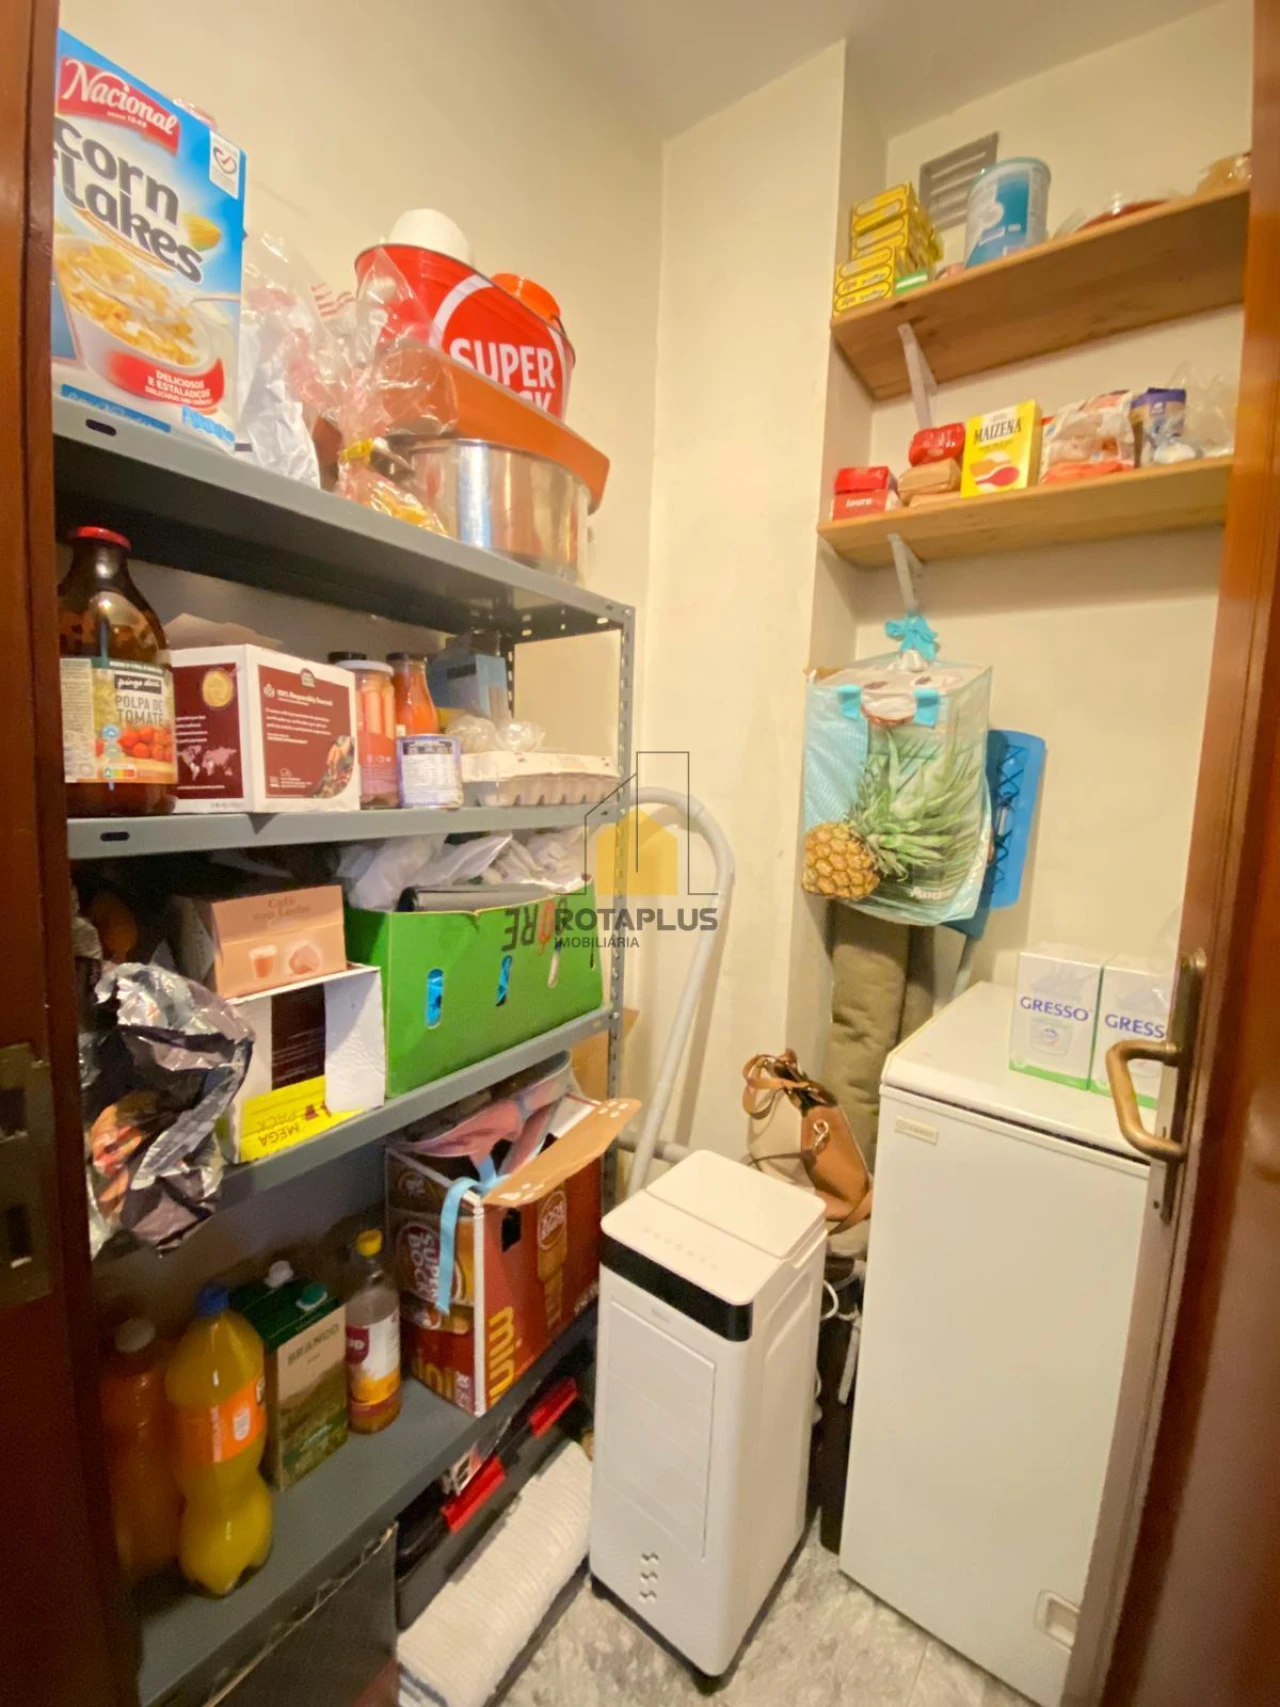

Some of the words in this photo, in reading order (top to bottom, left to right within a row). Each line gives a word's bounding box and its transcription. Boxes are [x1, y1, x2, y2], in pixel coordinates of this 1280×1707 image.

[62, 59, 177, 135] Nacional
[53, 117, 179, 226] corn
[53, 149, 203, 283] lakes
[449, 338, 556, 389] SUPER
[156, 369, 205, 389] DELICIOSOS
[973, 417, 1022, 445] MAIZENA
[115, 694, 150, 709] POLPA
[1020, 996, 1090, 1022] GRESSO
[258, 1122, 300, 1147] MEGA
